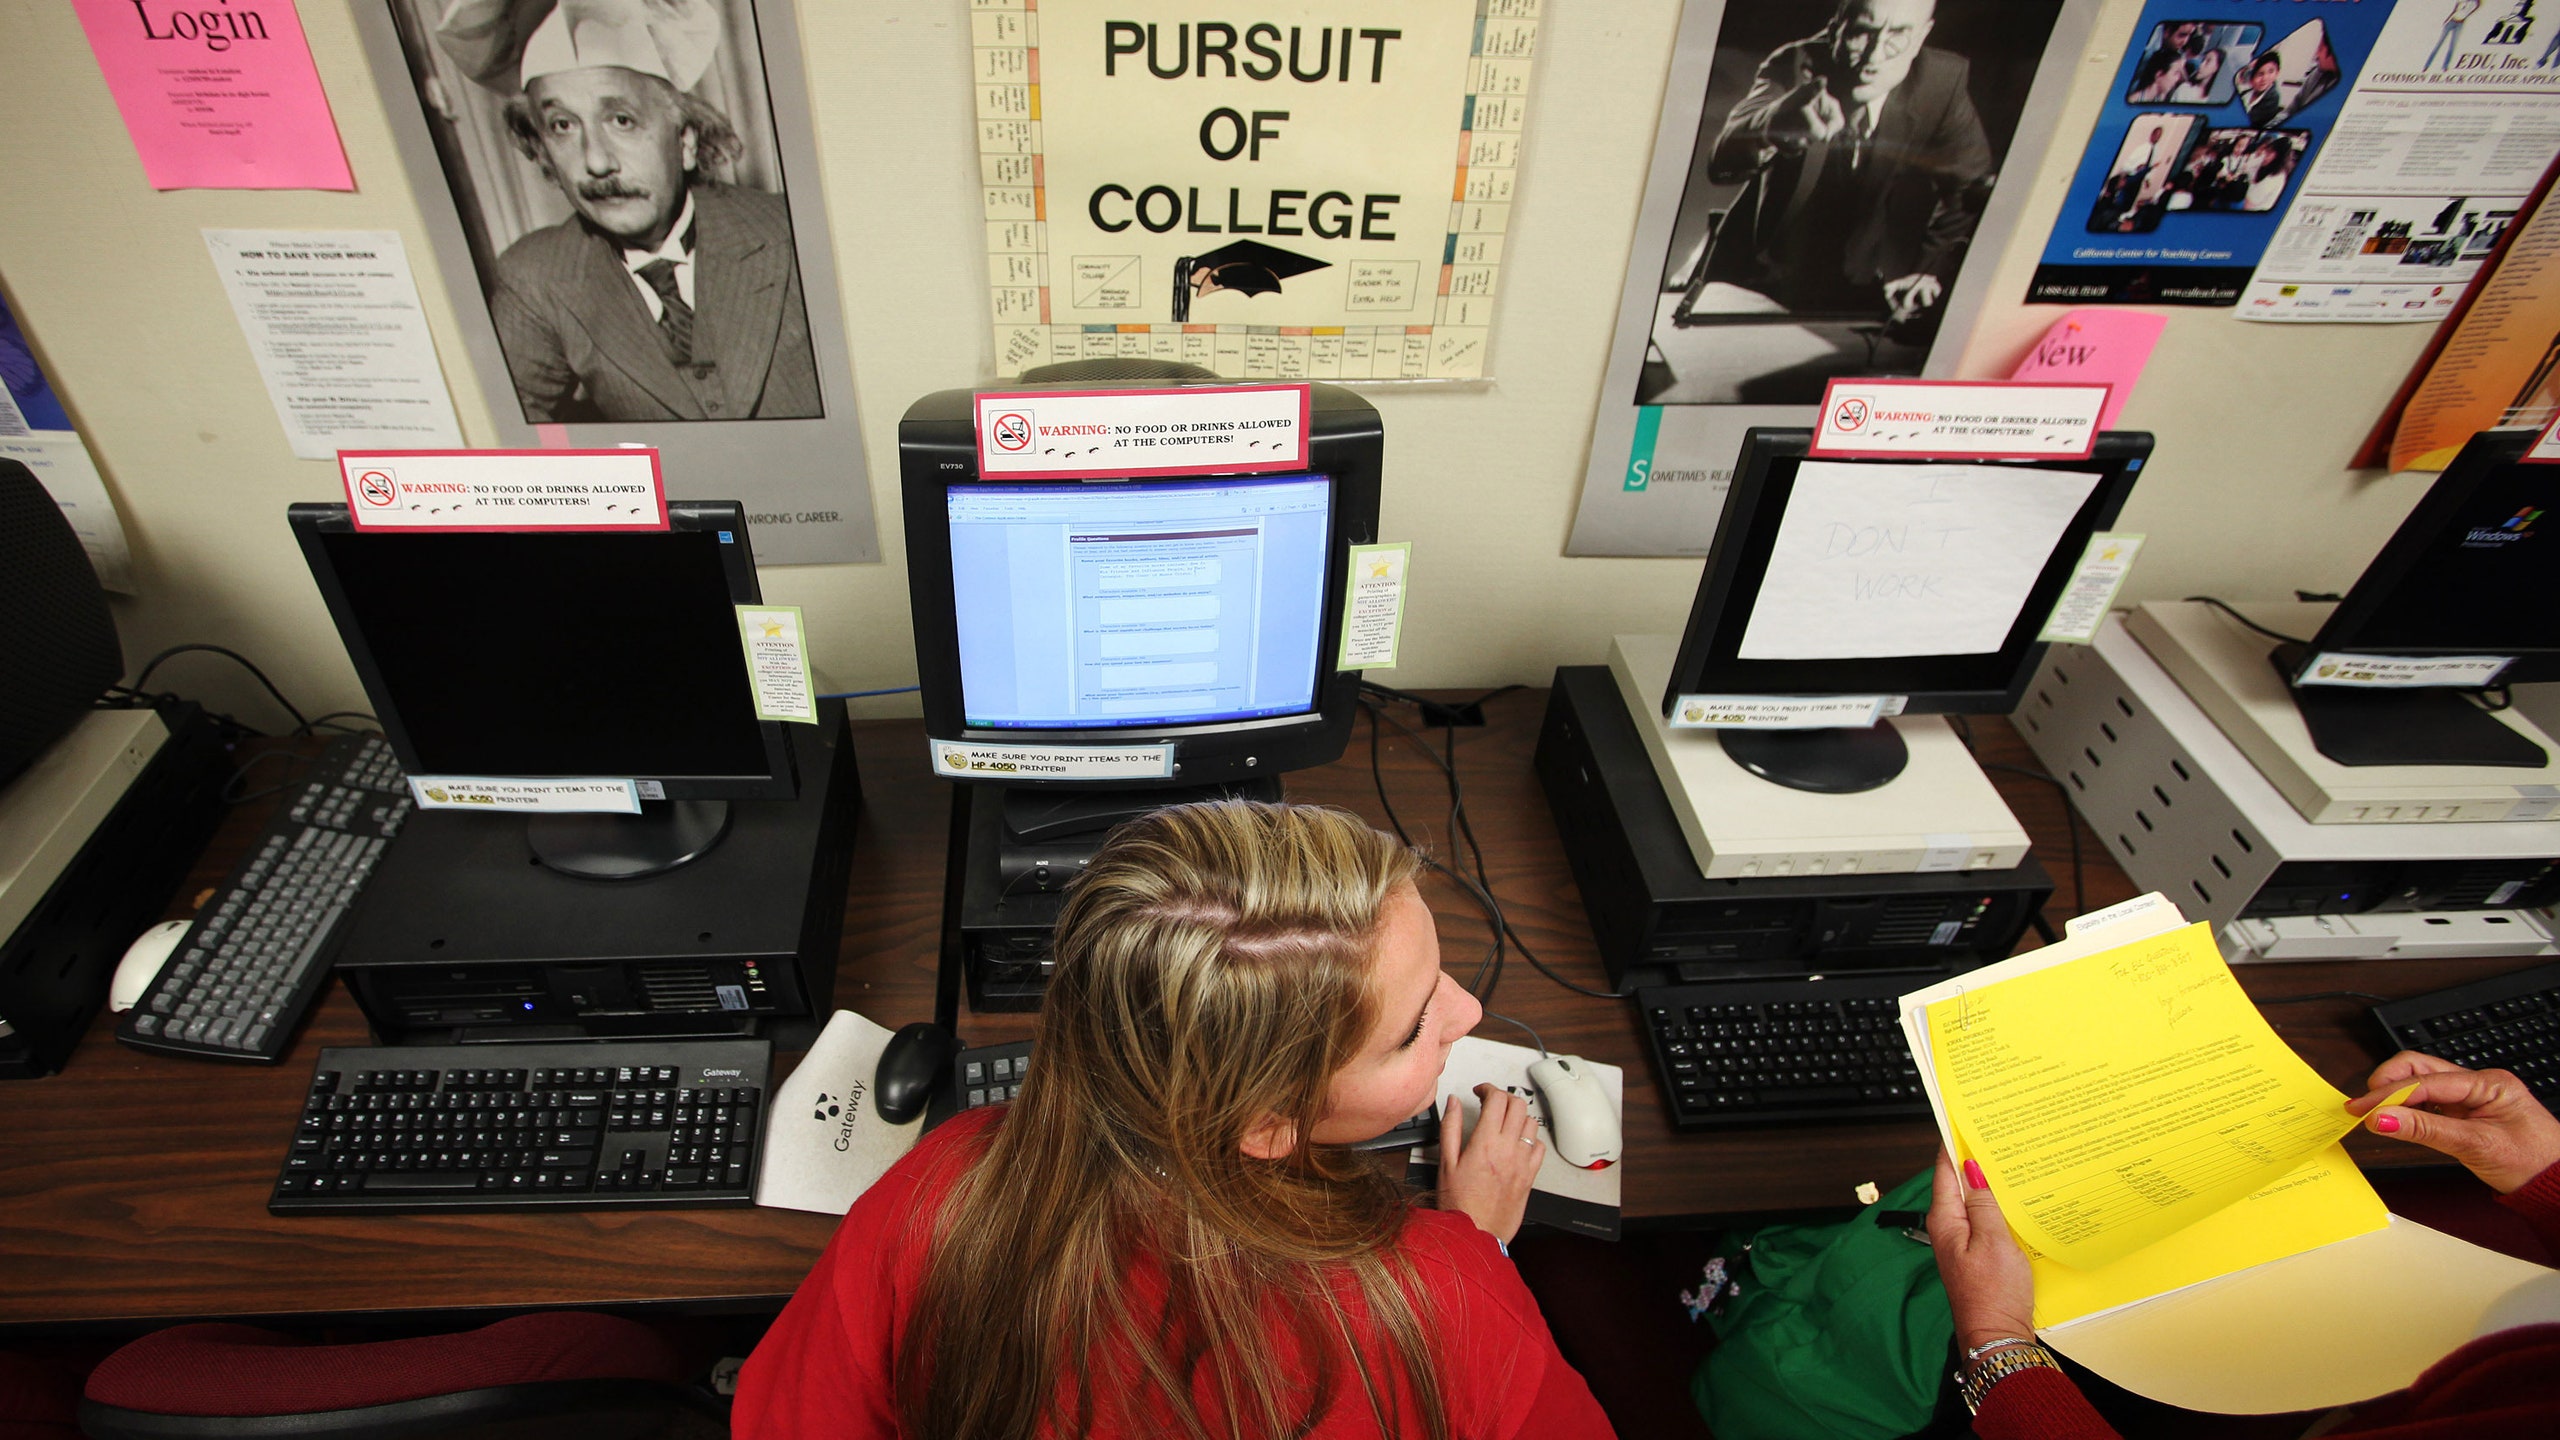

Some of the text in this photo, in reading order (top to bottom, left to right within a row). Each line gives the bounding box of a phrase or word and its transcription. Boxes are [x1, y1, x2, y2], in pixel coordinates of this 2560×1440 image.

[130, 0, 271, 52] Login
[1105, 21, 1402, 84] PURSUIT
[2500, 54, 2529, 70] Inc.
[2372, 73, 2426, 83] COMMON
[2429, 74, 2464, 84] BLACK
[2467, 75, 2517, 84] COLLEGE
[1200, 107, 1289, 162] OF
[1089, 183, 1401, 242] COLLEGE
[241, 252, 378, 260] HOW TO SAVE YOUR WORK
[2073, 247, 2232, 261] California Center for Teaching Careers
[1353, 295, 1375, 304] EXTRA
[1874, 411, 2088, 425] WARNING: NO FOOD OR DRINKS ALLOWED
[1039, 419, 1292, 437] WARNING: NO FOOD OR DRINKS ALLOWED
[1932, 426, 1947, 434] AT
[1113, 435, 1235, 448] AT THE COMPUTERS!
[401, 484, 646, 494] WARNING: NO FOOD OR DRINKS ALLOWED
[475, 497, 590, 506] AT THE COMPUTERS!
[796, 511, 843, 523] CAREER.
[2466, 530, 2522, 541] Windows
[1855, 573, 1944, 601] WORK
[1722, 714, 1746, 722] 4050
[971, 751, 997, 759] MAKE
[1001, 753, 1027, 761] SURE
[1030, 754, 1051, 762] YOU
[1054, 755, 1085, 763] PRINT
[1088, 755, 1121, 763] ITEMS
[1142, 754, 1161, 762] THE
[990, 762, 1017, 771] 4050
[1020, 764, 1066, 773] PRINTER!!
[448, 784, 472, 792] MAKE
[452, 794, 465, 802] HP
[468, 794, 494, 802] 4050
[2076, 919, 2100, 931] Eligibility
[2119, 908, 2133, 917] Local
[2135, 900, 2156, 912] Context
[702, 1068, 742, 1078] Gateway
